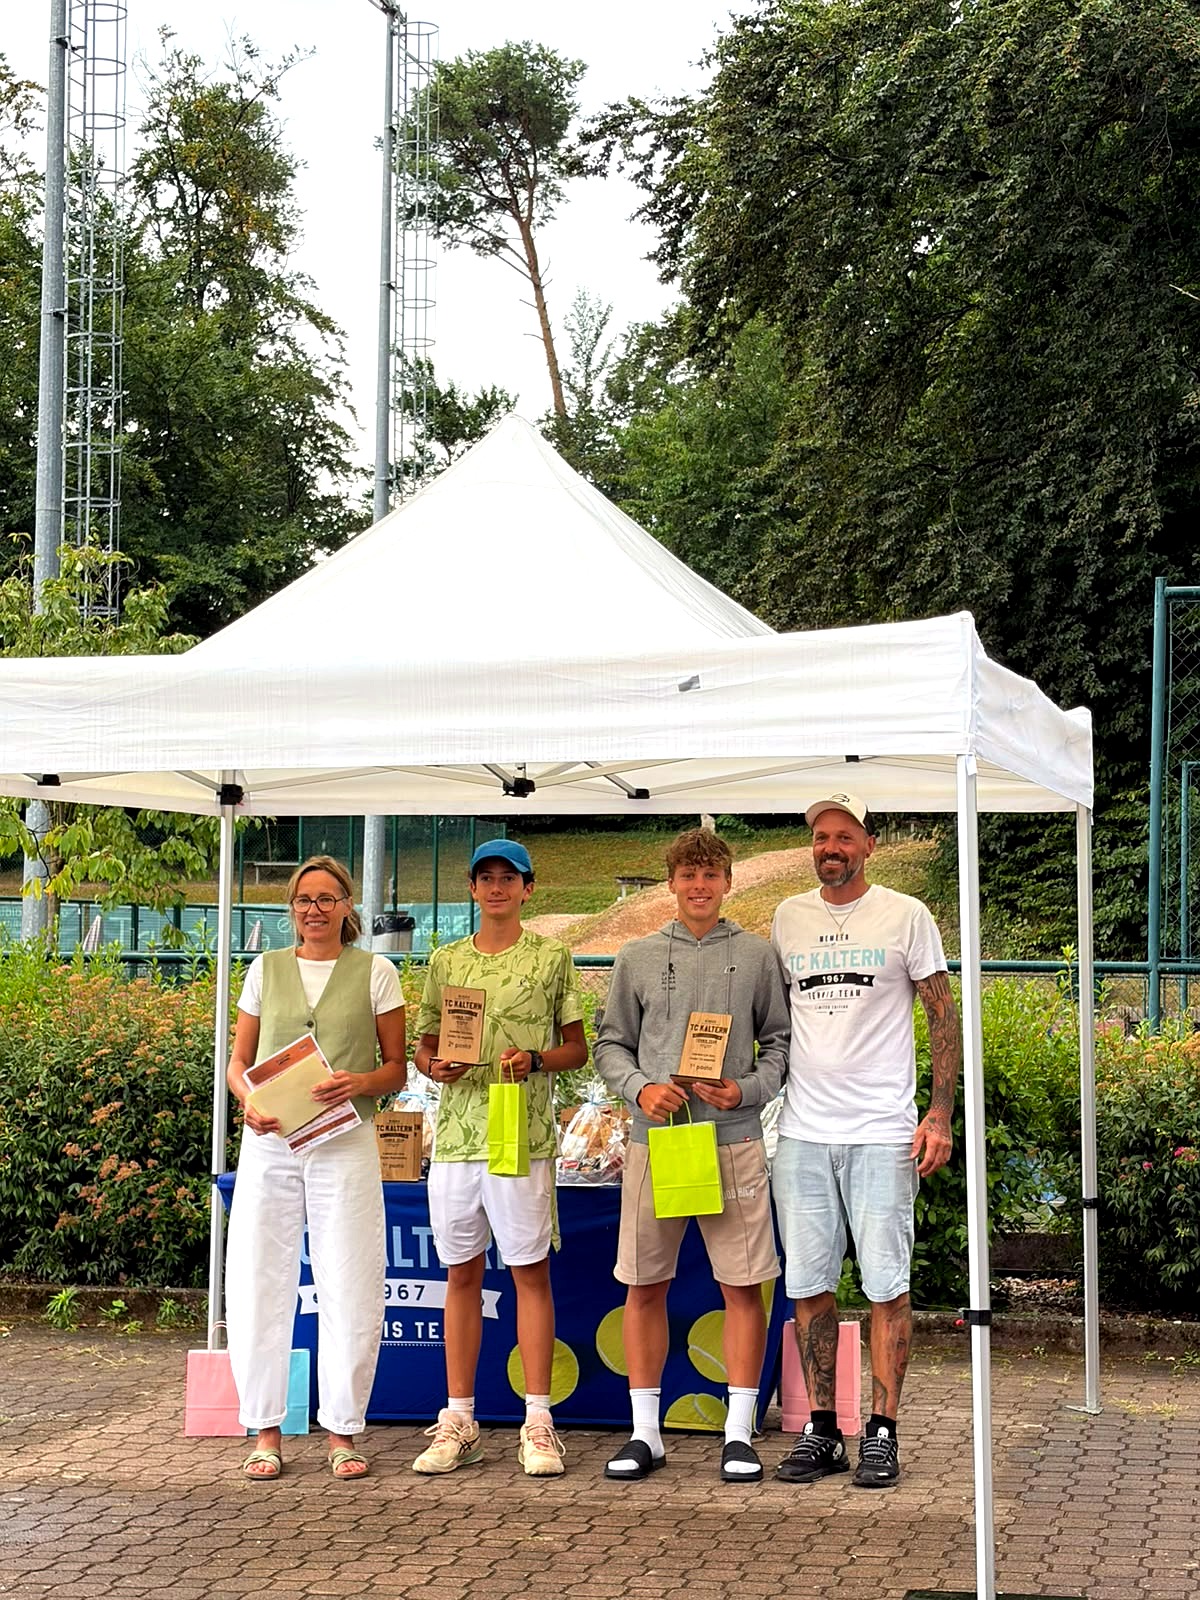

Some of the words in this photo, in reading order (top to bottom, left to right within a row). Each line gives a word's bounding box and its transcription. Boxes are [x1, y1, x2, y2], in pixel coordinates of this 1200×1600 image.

[789, 954, 805, 973] TC
[810, 948, 886, 970] KALTERN
[822, 974, 845, 984] 1967
[839, 989, 861, 998] TEAM
[444, 999, 453, 1007] TC
[454, 1000, 482, 1010] KALTERN
[690, 1023, 699, 1032] TC
[700, 1024, 729, 1034] KALTERN
[376, 1124, 385, 1132] TC
[385, 1284, 425, 1301] 967
[414, 1322, 445, 1339] TE
